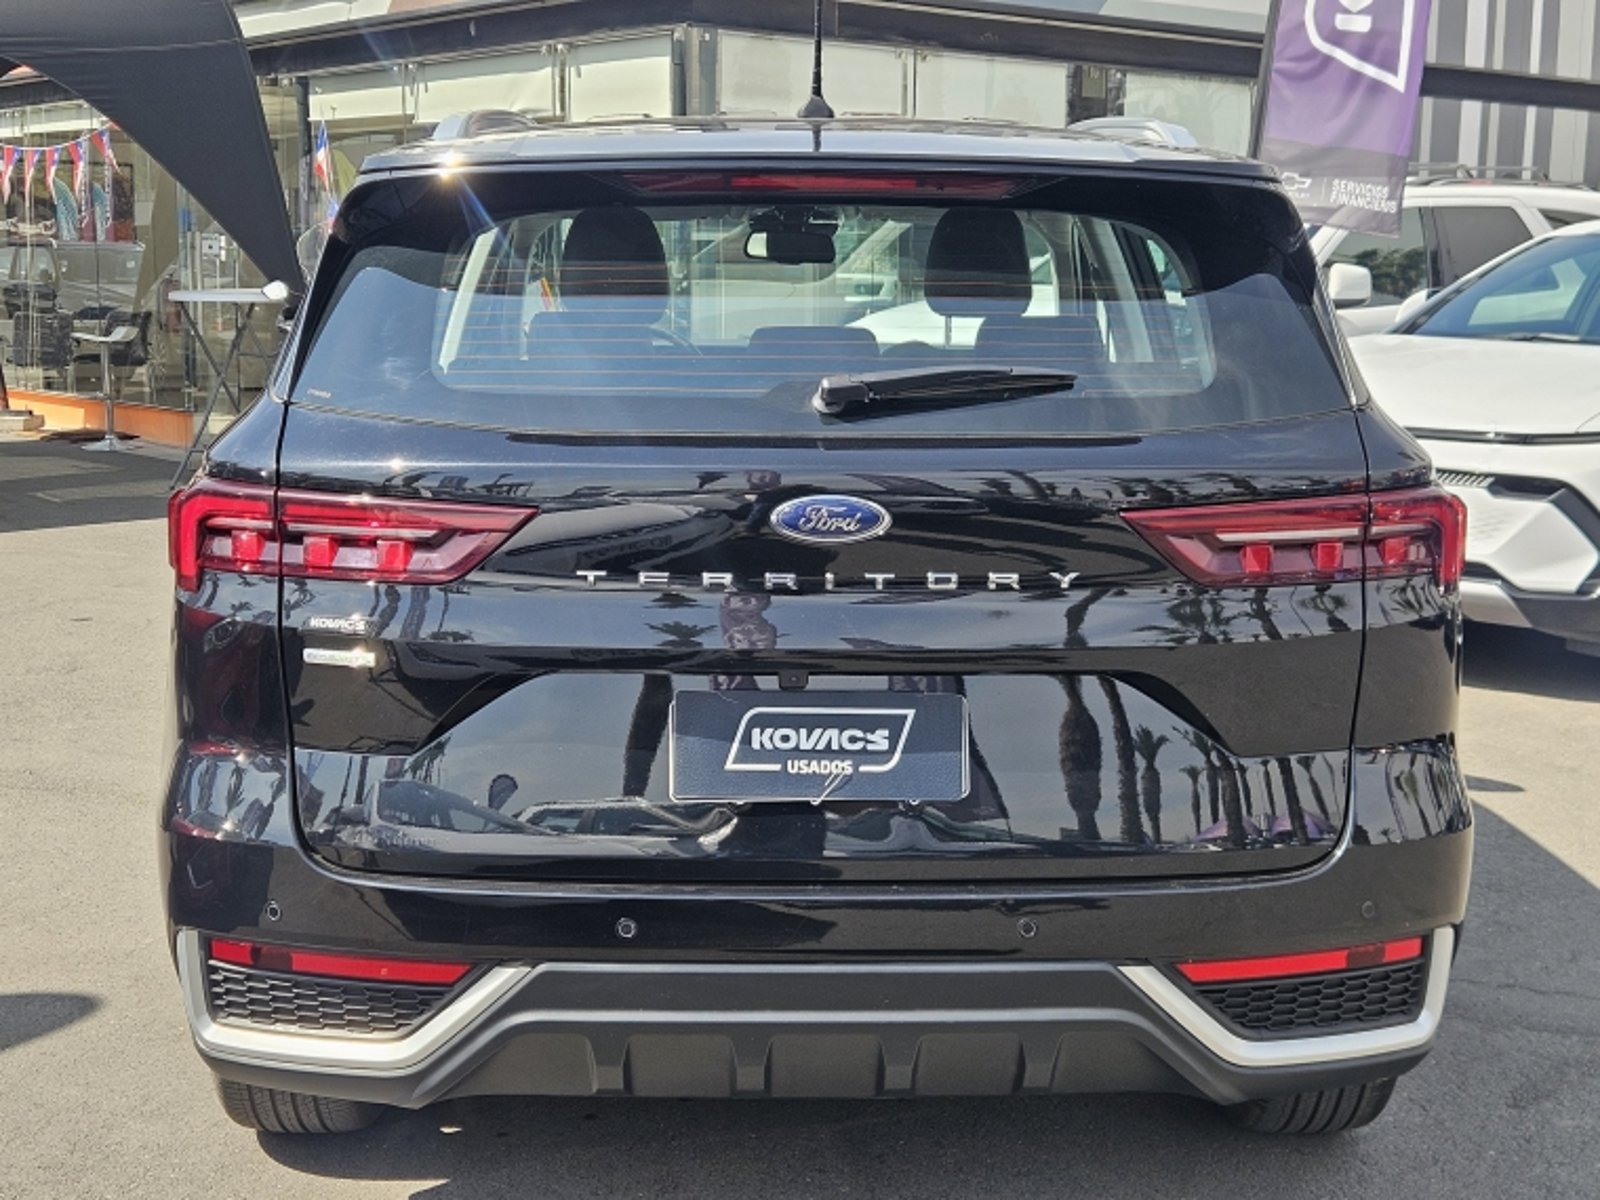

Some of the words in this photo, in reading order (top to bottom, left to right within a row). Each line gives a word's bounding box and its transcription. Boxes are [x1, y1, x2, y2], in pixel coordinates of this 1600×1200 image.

[1331, 179, 1389, 200] SERVICIOS
[799, 505, 861, 533] Ford
[576, 570, 1080, 592] TERRITORY
[310, 617, 366, 631] KOVACS
[751, 728, 889, 751] KOVACS
[787, 759, 854, 775] USADOS
